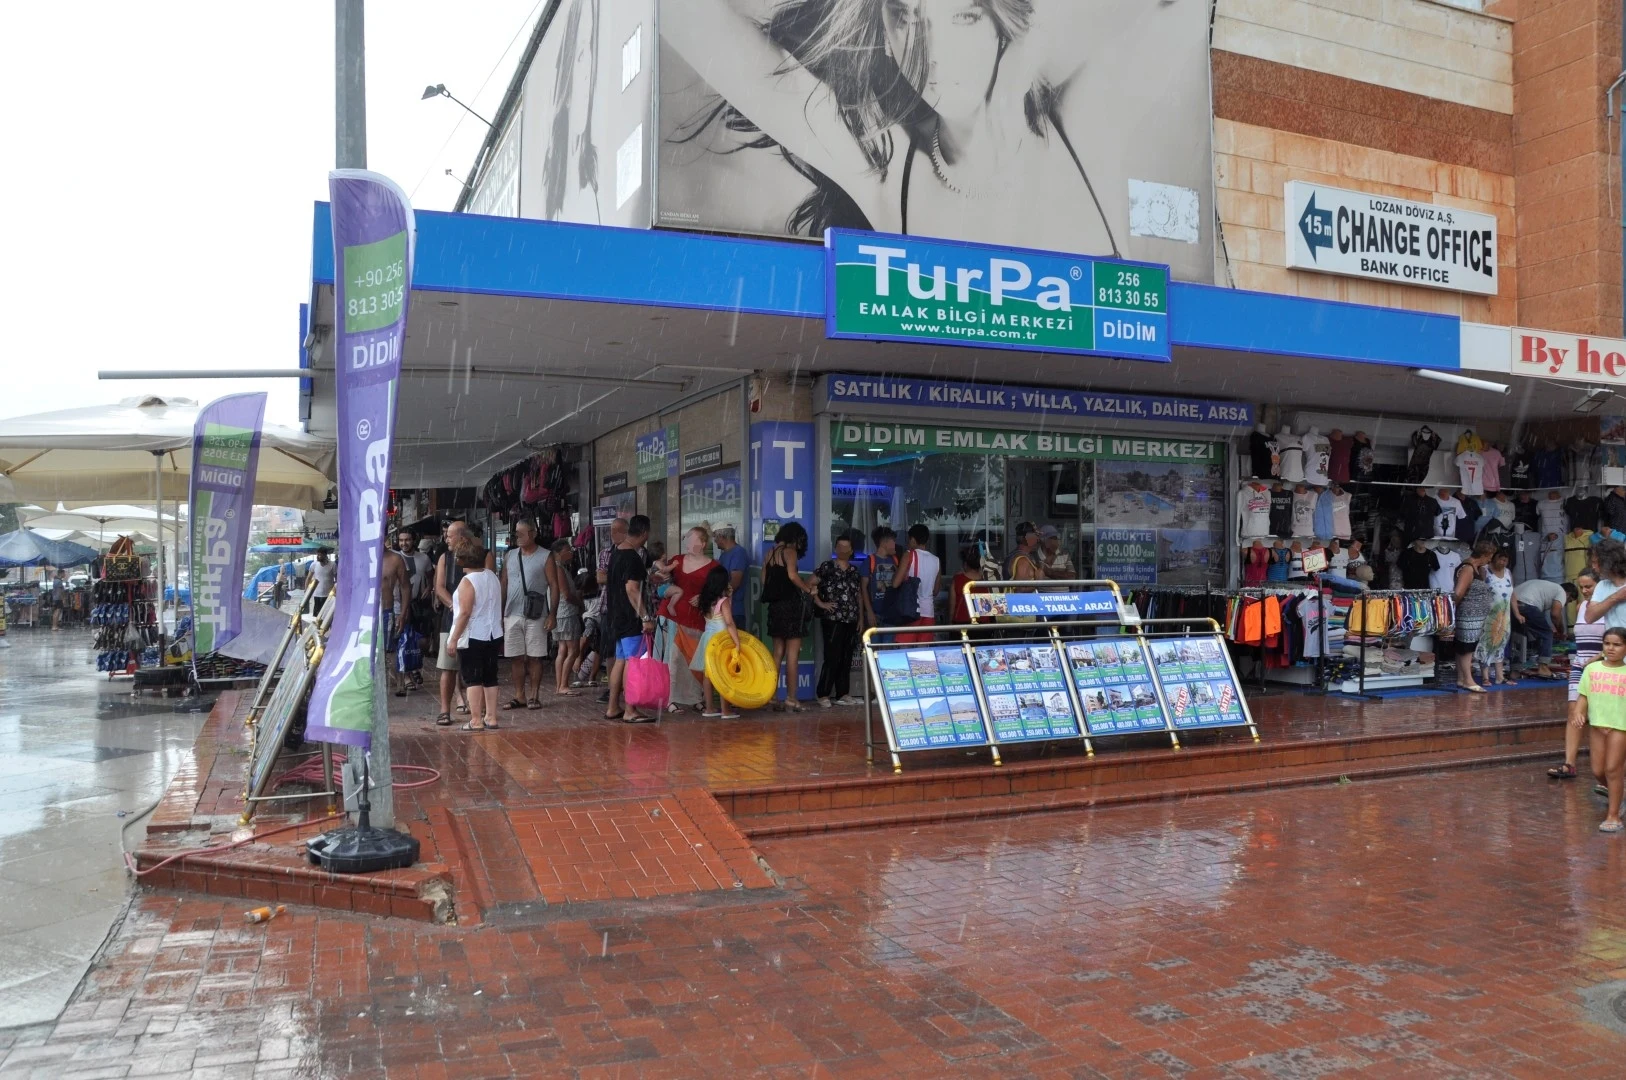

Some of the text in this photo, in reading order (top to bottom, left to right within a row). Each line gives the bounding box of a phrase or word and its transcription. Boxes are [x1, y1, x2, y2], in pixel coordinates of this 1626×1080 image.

[1370, 200, 1402, 215] LOZAN
[1337, 205, 1493, 278] CHANGE OFFICE
[354, 260, 403, 288] +90 256
[1118, 272, 1140, 287] 256
[1361, 258, 1449, 284] BANK OFFICE
[348, 296, 377, 316] 813
[1098, 287, 1158, 308] 813 30 55
[859, 302, 1074, 331] EMLAK BİLGİ MERKEZİ
[900, 322, 1038, 340] www.turpa.com.tr
[1103, 320, 1156, 342] DİDİM
[1520, 335, 1569, 374] By
[834, 380, 912, 400] SATILIK
[928, 379, 1006, 406] KİRALIK
[1022, 389, 1078, 414] VİLLA,
[1084, 396, 1147, 417] YAZLIK,
[1152, 400, 1204, 421] DAİRE,
[1208, 406, 1248, 422] ARSA
[843, 421, 1215, 459] DİDİM EMLAK BİLGİ MERKEZİ
[1468, 467, 1476, 484] 7
[1097, 544, 1104, 556] €
[1012, 604, 1039, 613] ARSA
[1045, 604, 1078, 612] TARLA
[1084, 600, 1113, 610] ARAZİ
